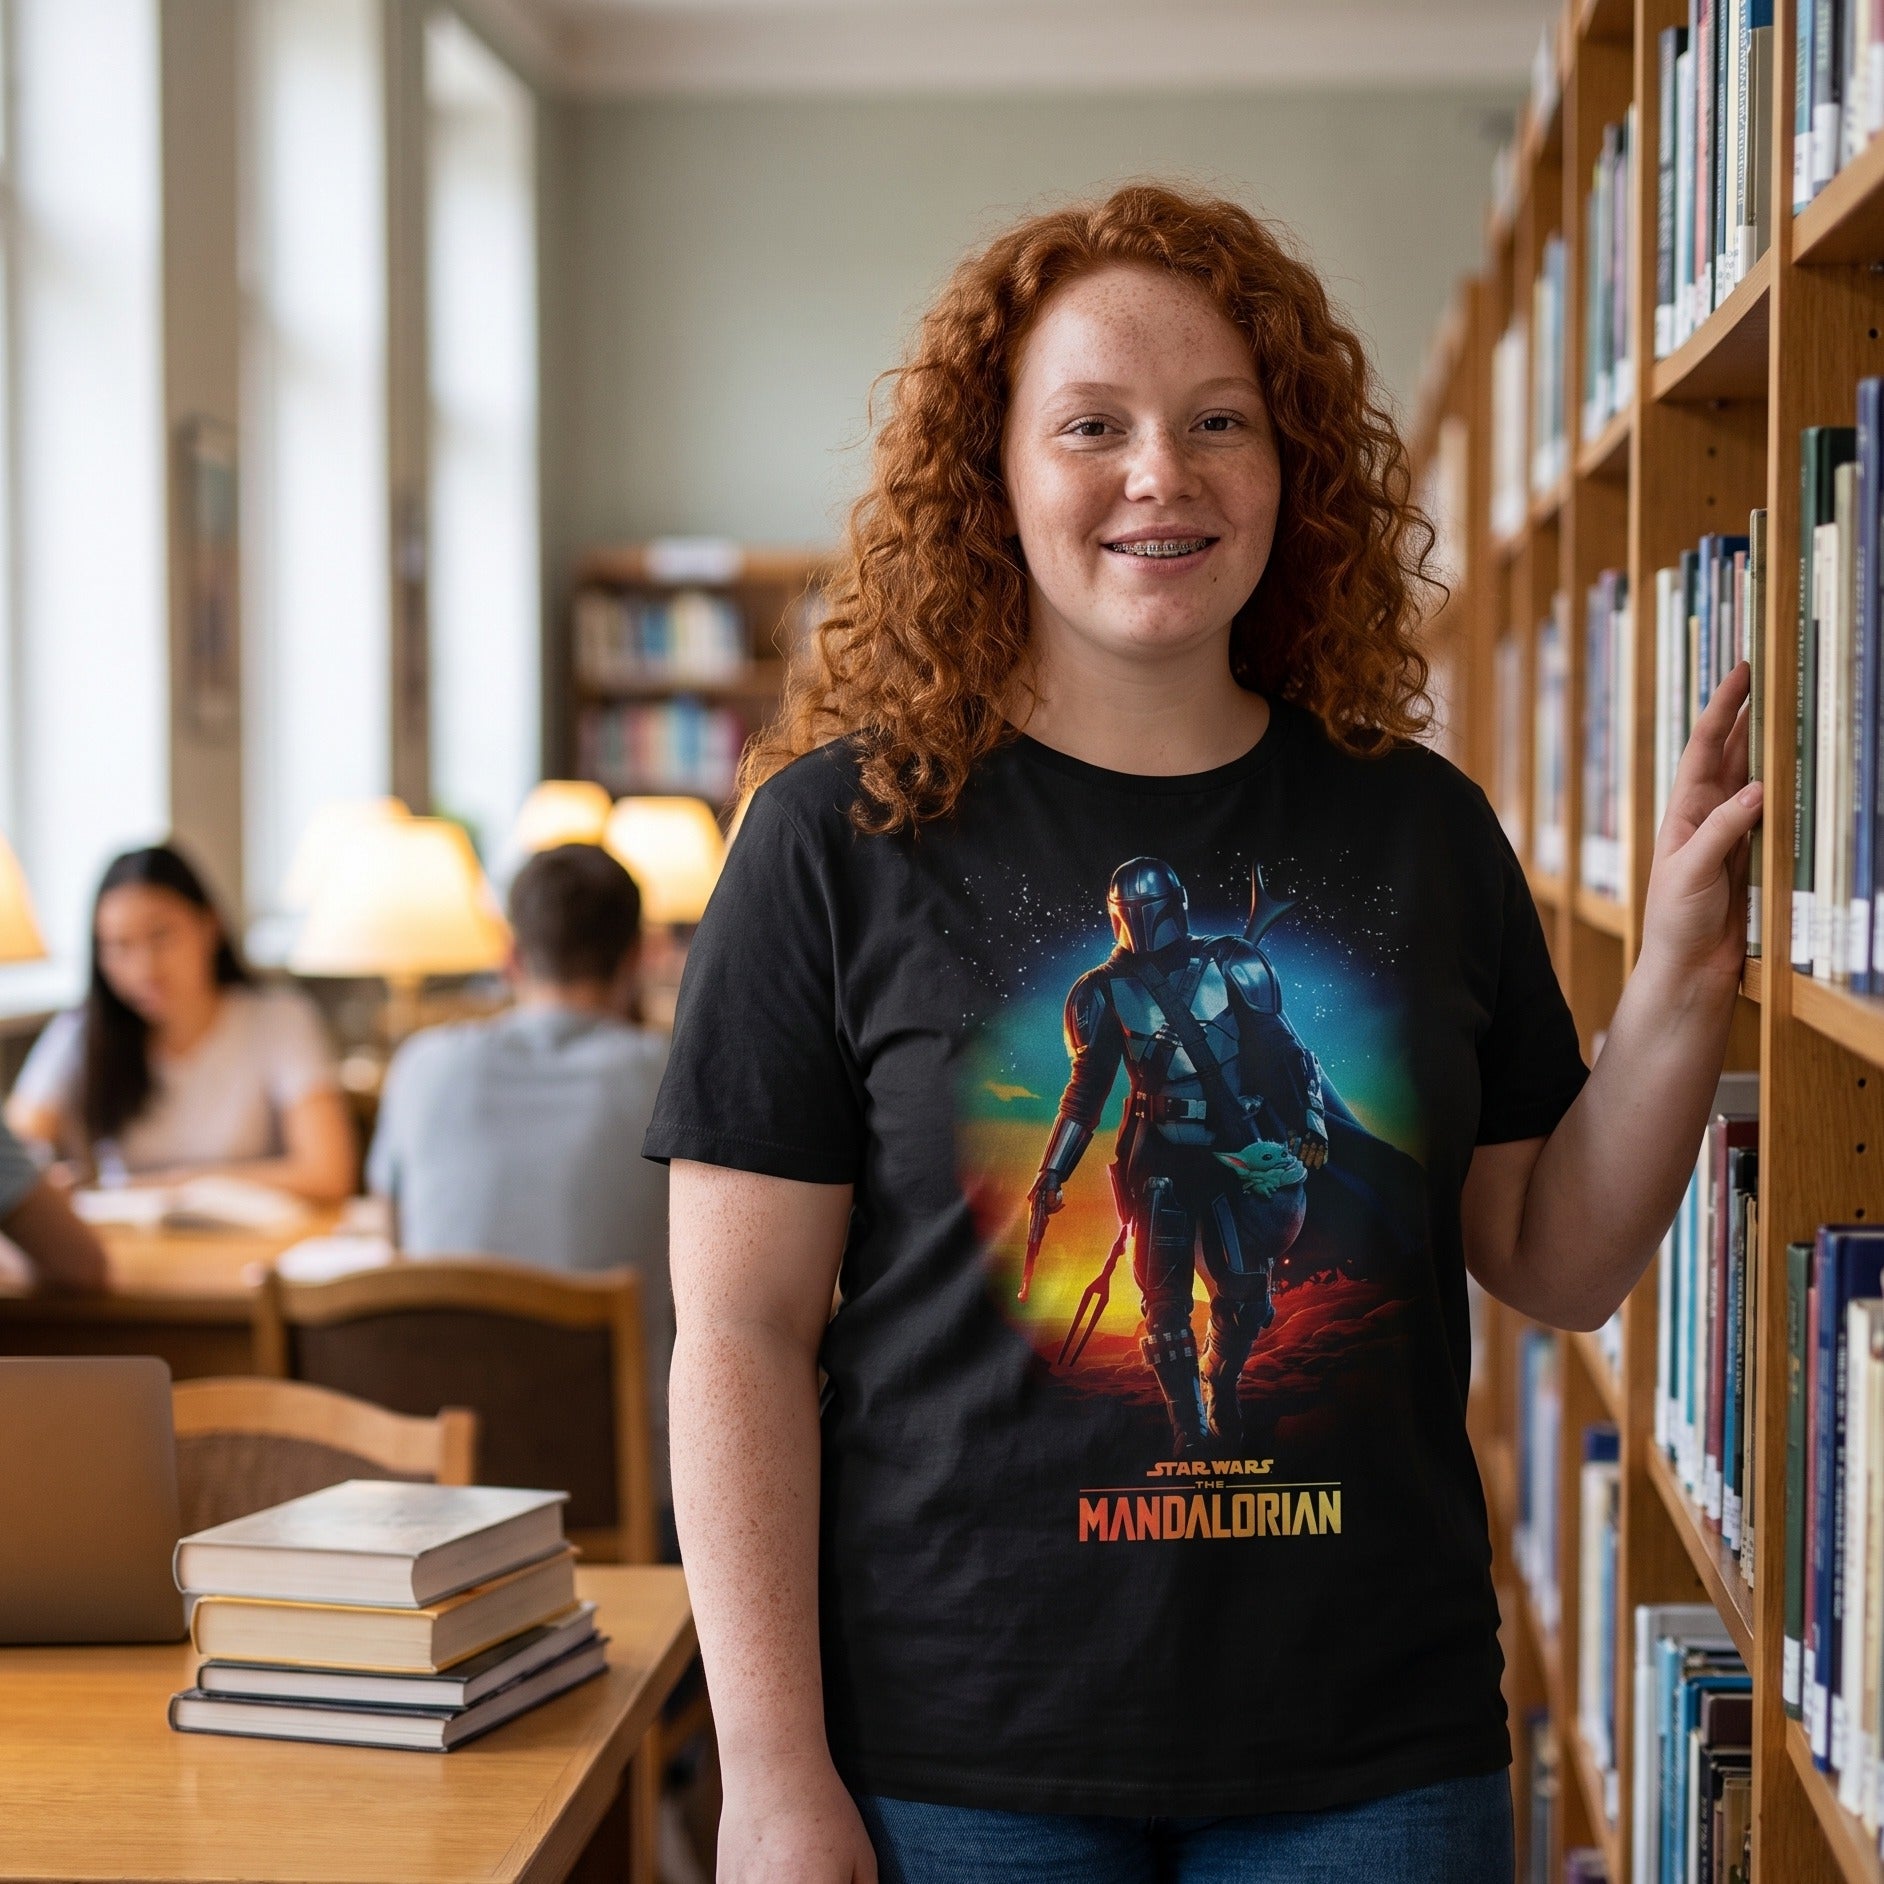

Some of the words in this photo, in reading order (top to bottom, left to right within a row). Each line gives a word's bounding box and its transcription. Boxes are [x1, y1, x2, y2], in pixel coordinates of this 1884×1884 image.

[1146, 1461, 1211, 1477] STAR
[1211, 1459, 1274, 1475] WARS
[1195, 1480, 1225, 1490] THE
[1079, 1490, 1341, 1542] MANDALORIAN
